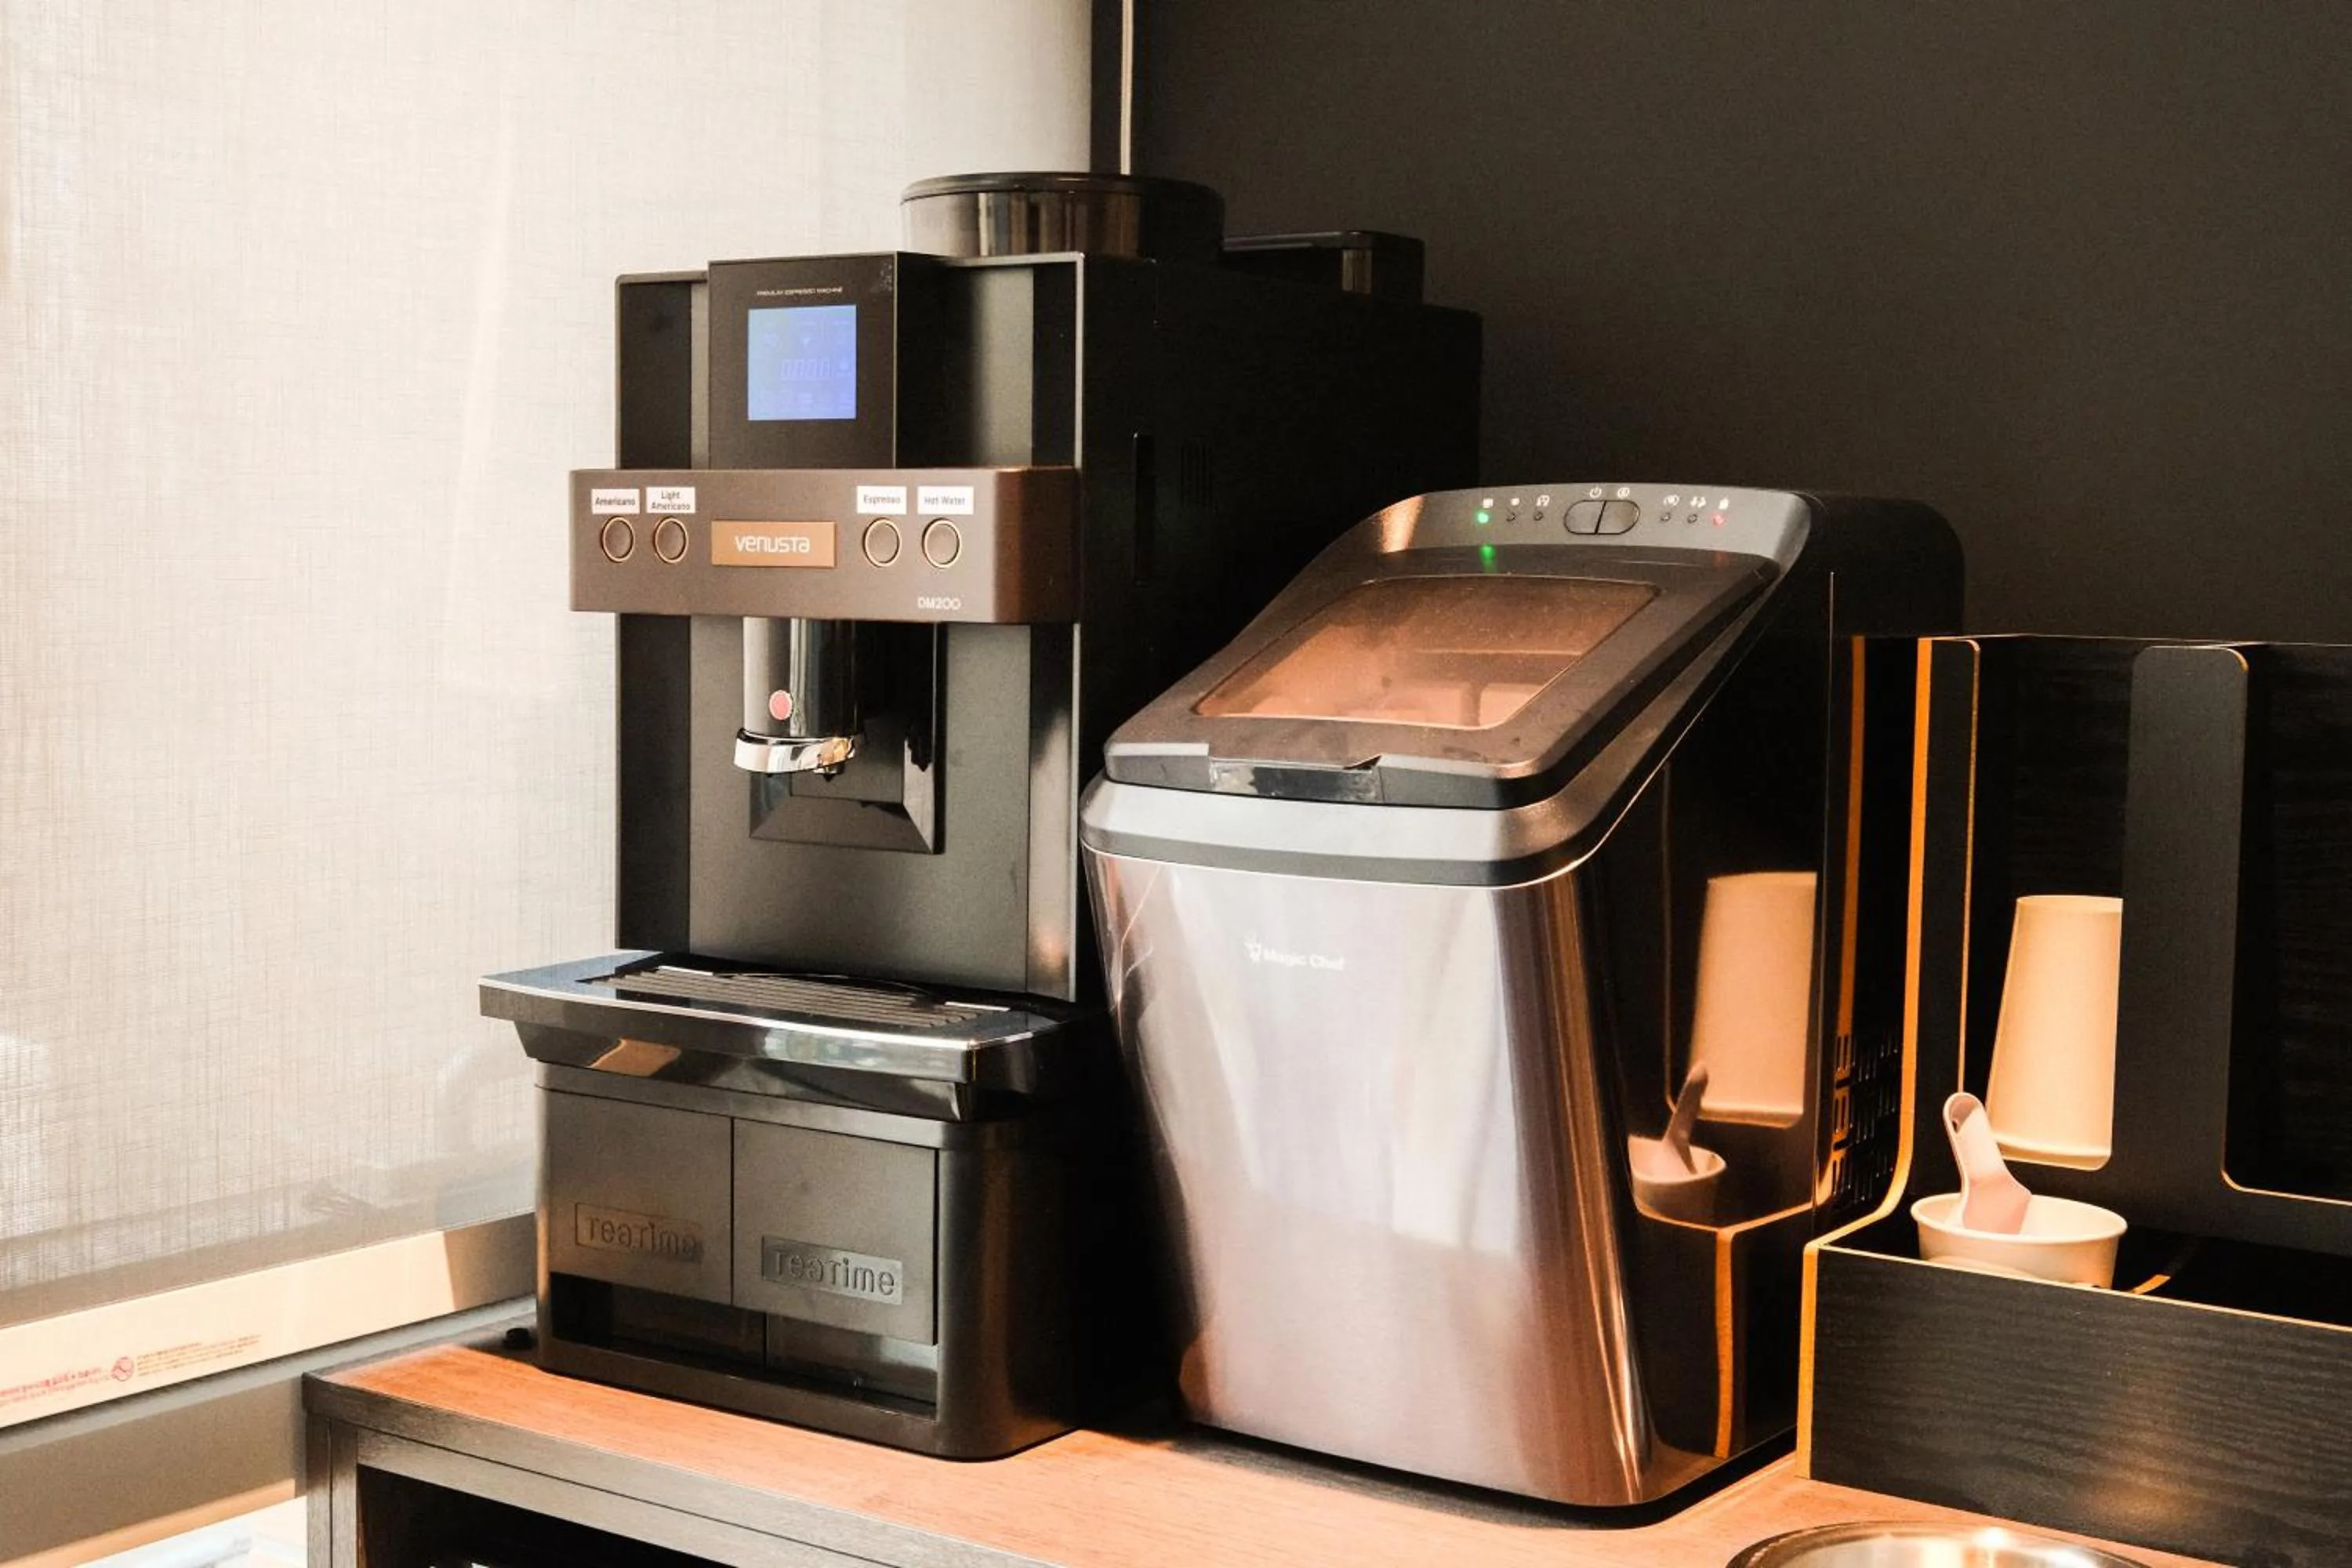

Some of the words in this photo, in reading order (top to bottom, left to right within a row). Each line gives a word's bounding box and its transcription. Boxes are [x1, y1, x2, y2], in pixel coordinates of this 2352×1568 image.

[661, 491, 681, 500] Light
[863, 494, 902, 506] Espresso
[924, 495, 938, 505] Hot
[941, 495, 965, 506] Water
[595, 496, 636, 506] Americano
[652, 501, 691, 510] Americano
[917, 597, 961, 610] DM200
